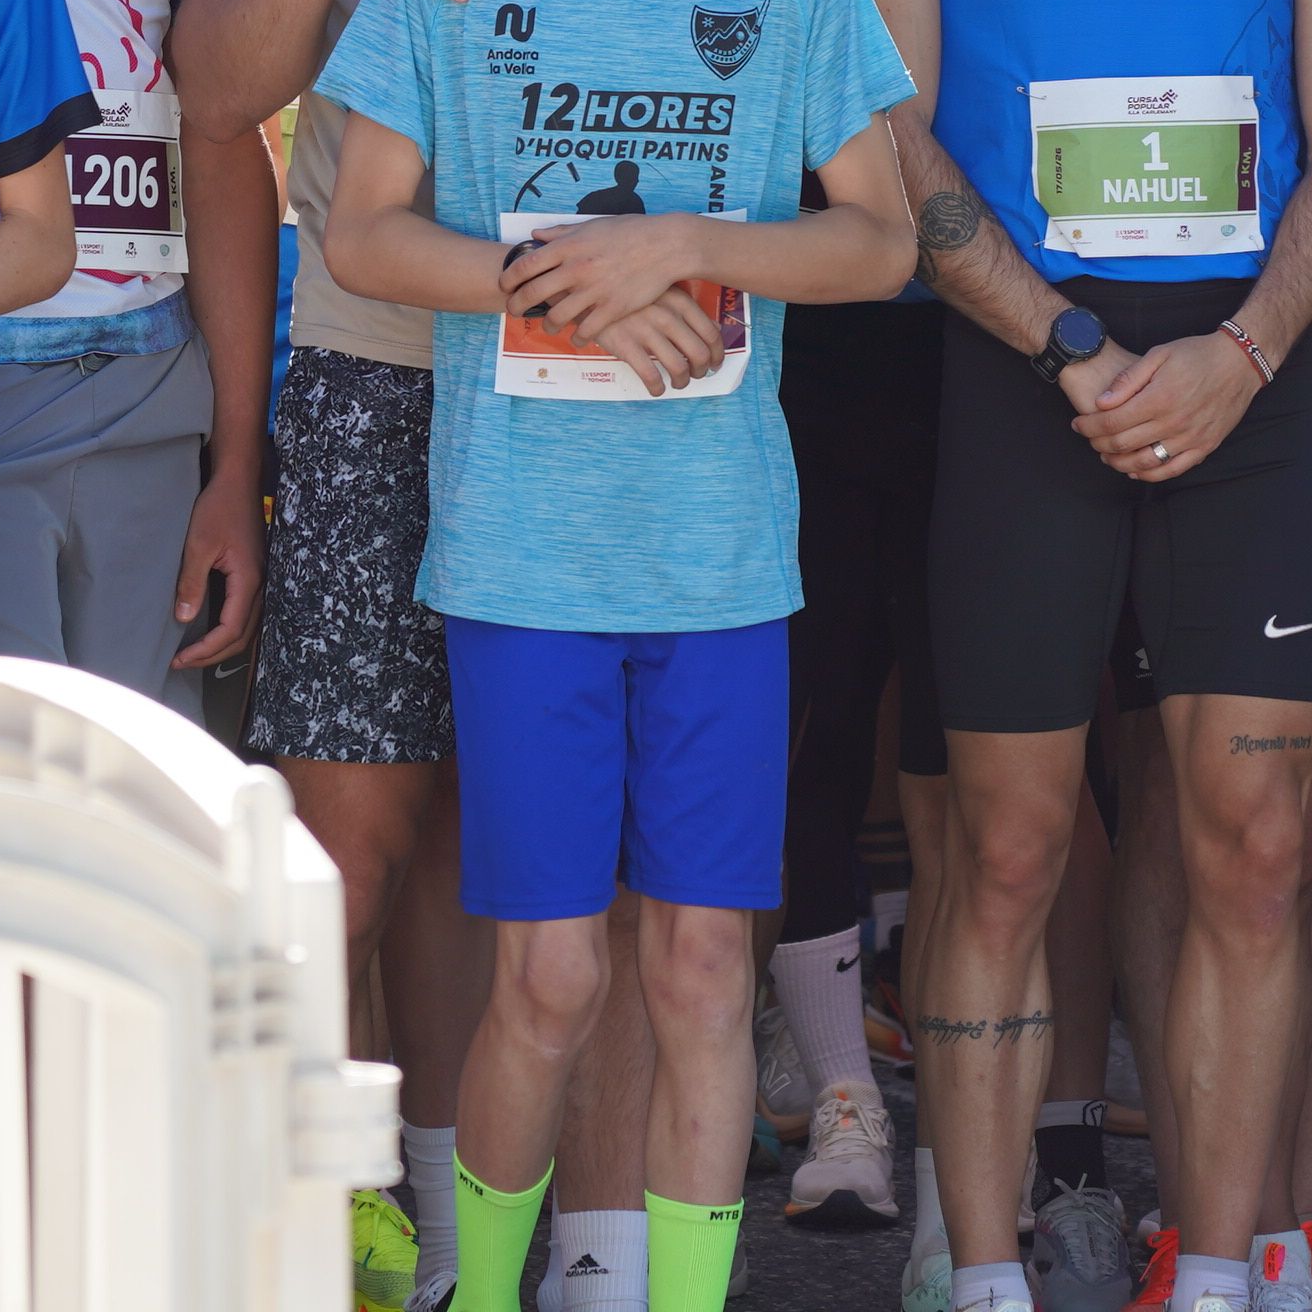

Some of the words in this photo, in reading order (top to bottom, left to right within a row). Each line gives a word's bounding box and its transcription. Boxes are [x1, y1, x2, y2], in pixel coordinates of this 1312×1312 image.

[487, 48, 539, 62] Andorra
[490, 63, 501, 75] la
[504, 63, 536, 75] Vella
[521, 82, 580, 131] 12
[585, 94, 734, 131] HORES
[1127, 96, 1159, 104] CURSA
[100, 108, 116, 116] RSA
[515, 137, 637, 161] D'HOQUEI
[641, 140, 730, 163] PATINS
[1141, 131, 1170, 171] 1
[1241, 146, 1252, 175] KM.
[1055, 147, 1063, 195] 17/05/26
[1103, 177, 1208, 203] NAHUEL
[1240, 179, 1250, 188] 5
[171, 200, 178, 208] 5
[725, 315, 737, 327] 5
[459, 1172, 484, 1196] MTB
[709, 1210, 739, 1221] MTB
